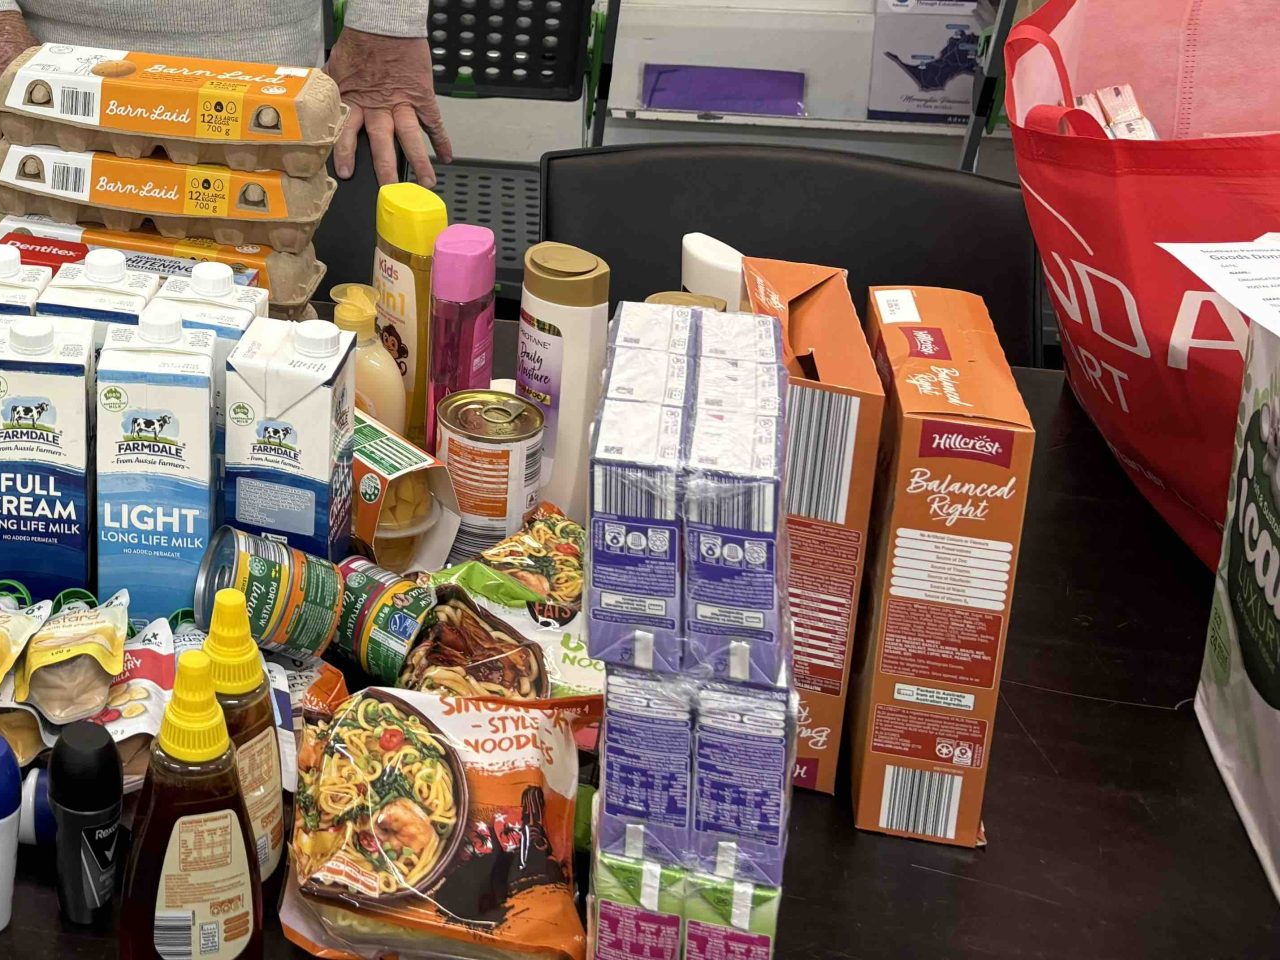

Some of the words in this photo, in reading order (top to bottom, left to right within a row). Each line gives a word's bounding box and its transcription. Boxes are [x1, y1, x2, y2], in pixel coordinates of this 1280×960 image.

[144, 64, 216, 78] Barn
[217, 69, 286, 84] Laid
[106, 99, 150, 119] Barn
[150, 105, 192, 124] Laid
[206, 124, 222, 134] 700
[224, 127, 231, 137] g
[95, 175, 137, 194] Barn
[137, 182, 179, 201] Laid
[193, 201, 208, 211] 700
[211, 204, 218, 213] g
[378, 256, 400, 282] Kids
[520, 340, 544, 371] Daily
[13, 445, 36, 453] Aussie
[35, 445, 63, 458] Farmers
[117, 442, 184, 459] FARMDALE
[251, 444, 300, 461] FARMDALE
[931, 432, 1000, 457] Hillcrest
[115, 456, 134, 466] From
[133, 457, 158, 466] Aussie
[157, 458, 186, 470] Farmers
[250, 455, 264, 463] From
[263, 456, 281, 465] Aussie
[280, 459, 301, 471] Farmers
[0, 471, 63, 498] FULL
[906, 466, 1018, 501] Balanced
[102, 501, 201, 535] LIGHT
[926, 493, 990, 528] Right
[19, 519, 47, 533] LIFE
[47, 521, 81, 536] MILK
[11, 535, 32, 543] ADDED
[31, 536, 59, 544] PERMEATE
[100, 530, 139, 545] LONG
[141, 532, 169, 548] LIFE
[170, 533, 204, 549] MILK
[123, 547, 133, 555] NO
[132, 548, 153, 557] ADDED
[152, 549, 182, 559] PERMEATE
[258, 580, 279, 629] PORTVIEW
[345, 591, 368, 639] PORTVIEW
[915, 696, 942, 705] Australian
[942, 700, 972, 709] ingredients
[941, 690, 966, 699] Australia
[582, 704, 590, 714] 4
